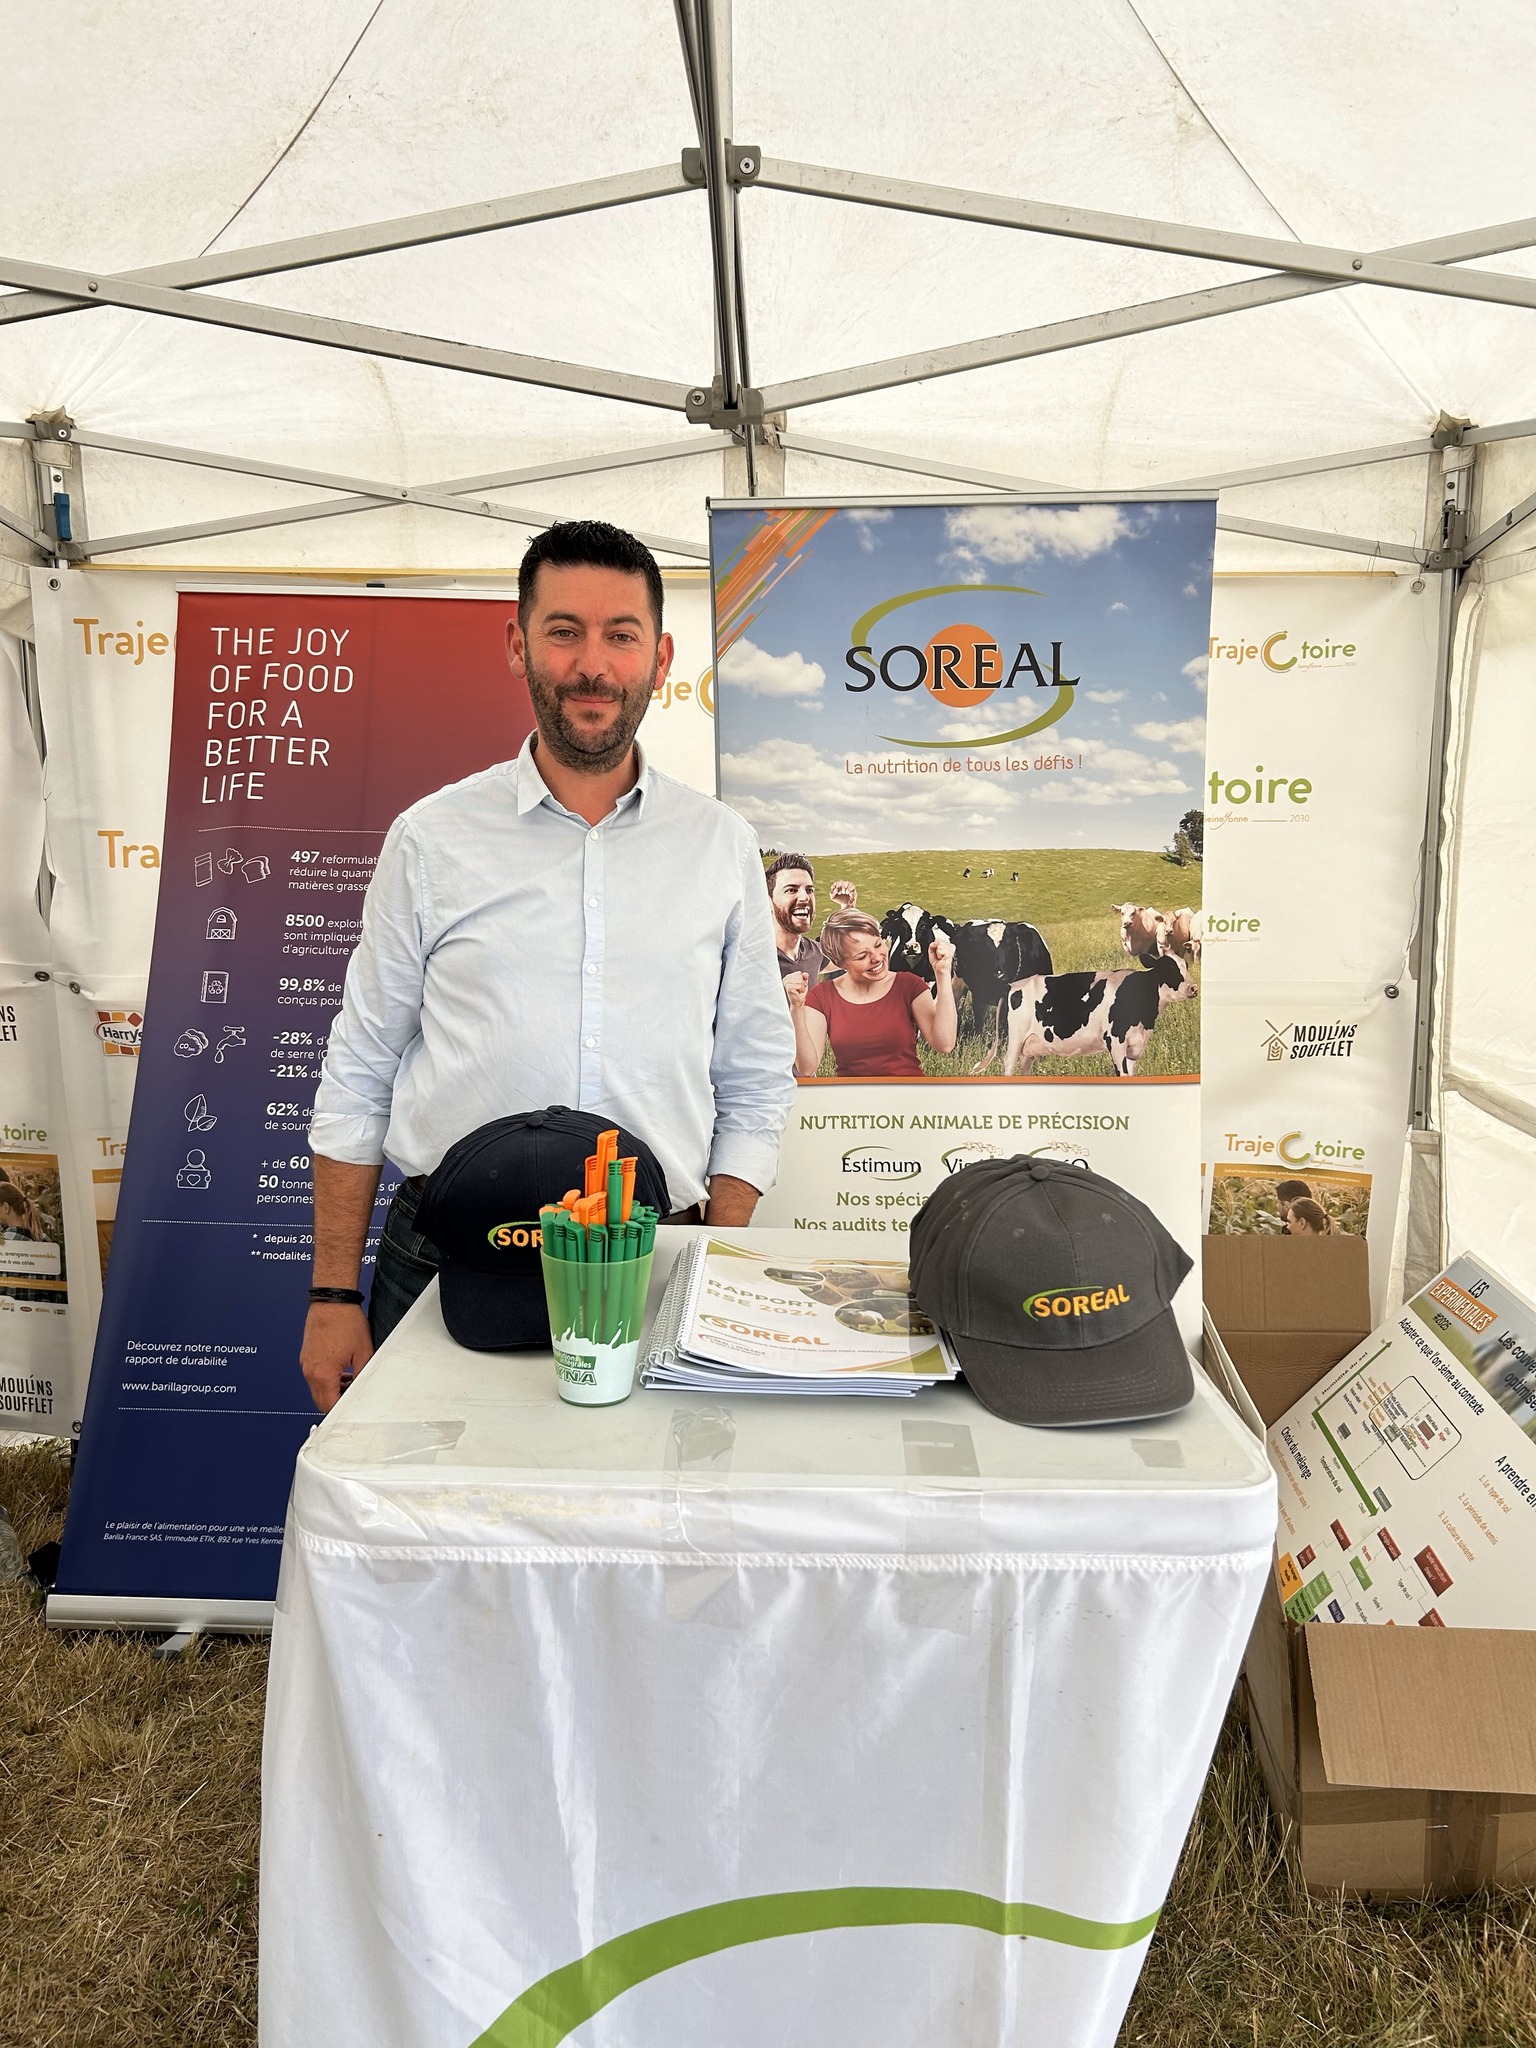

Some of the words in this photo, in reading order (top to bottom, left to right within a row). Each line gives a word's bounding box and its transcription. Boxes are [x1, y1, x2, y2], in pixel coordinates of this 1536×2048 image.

[211, 628, 275, 656] THE
[288, 628, 350, 656] JOY
[845, 640, 1081, 693] SOREAL
[210, 665, 252, 693] OF
[263, 663, 354, 693] FOOD
[208, 699, 267, 730] FOR
[281, 701, 303, 728] A
[205, 735, 330, 767] BETTER
[846, 759, 864, 775] La
[867, 758, 939, 775] nutrition
[942, 757, 963, 774] de
[966, 758, 1001, 773] tous
[1004, 756, 1029, 772] les
[1032, 753, 1074, 771] défis
[201, 772, 266, 803] LIFE
[1208, 765, 1312, 804] toire
[1290, 814, 1310, 823] 2030
[291, 851, 320, 864] 497
[290, 867, 327, 877] réduire
[330, 868, 339, 877] la
[288, 881, 334, 891] matières
[336, 883, 369, 893] grasse
[285, 914, 325, 928] 8500
[1207, 912, 1261, 933] toire
[284, 932, 307, 941] sont
[310, 931, 362, 943] impliquée
[282, 944, 349, 956] d'agriculture
[279, 978, 325, 993] 99,8%
[328, 983, 341, 992] de
[278, 996, 317, 1007] conçus
[273, 1032, 313, 1045] -28%
[270, 1049, 284, 1058] de
[288, 1050, 314, 1059] serre
[1290, 1040, 1354, 1060] SOUFFLET
[269, 1065, 308, 1078] -21%
[266, 1103, 299, 1116] 62%
[264, 1120, 279, 1130] de
[800, 1114, 905, 1131] NUTRITION
[909, 1115, 993, 1130] ANIMALE
[999, 1115, 1022, 1129] DE
[1028, 1112, 1130, 1131] PRÉCISION
[272, 1159, 286, 1169] de
[289, 1156, 310, 1170] 60
[842, 1157, 922, 1174] Estimum
[258, 1176, 278, 1189] 50
[257, 1194, 314, 1204] personnes
[836, 1191, 870, 1207] Nos
[794, 1218, 827, 1231] Nos
[832, 1217, 886, 1232] audits
[891, 1218, 909, 1232] te
[264, 1234, 297, 1245] depuis
[299, 1234, 315, 1244] 20
[262, 1251, 312, 1261] modalités
[709, 1279, 818, 1308] RAPPORT
[1468, 1278, 1490, 1299] LES
[706, 1289, 751, 1307] RSE
[759, 1305, 818, 1318] 2024
[1034, 1284, 1130, 1318] SOREAL
[1429, 1281, 1493, 1331] EXPÉRIMENTALES
[711, 1316, 830, 1346] SOREAL
[127, 1340, 182, 1352] Découvrez
[184, 1343, 212, 1353] notre
[214, 1345, 258, 1354] nouveau
[1498, 1330, 1516, 1350] Les
[1511, 1345, 1536, 1374] couver
[125, 1355, 163, 1365] rapport
[165, 1356, 179, 1365] de
[181, 1356, 228, 1367] durabilité
[1398, 1317, 1420, 1340] Adapter
[1415, 1337, 1425, 1348] ce
[1420, 1343, 1433, 1357] que
[1440, 1364, 1455, 1383] sème
[1451, 1378, 1463, 1390] au
[1458, 1387, 1485, 1416] contexte
[122, 1381, 237, 1394] www.barillagroup.com
[1504, 1373, 1536, 1411] optimise
[1281, 1426, 1295, 1447] Choix
[1289, 1443, 1299, 1454] du
[1294, 1452, 1312, 1480] mélange
[1495, 1455, 1507, 1467] A
[1498, 1463, 1531, 1496] prendre
[105, 1521, 115, 1529] Le
[116, 1521, 141, 1531] plaisir
[142, 1522, 153, 1530] de
[154, 1522, 207, 1531] l'alimentation
[208, 1525, 228, 1533] pour
[260, 1525, 285, 1534] meille
